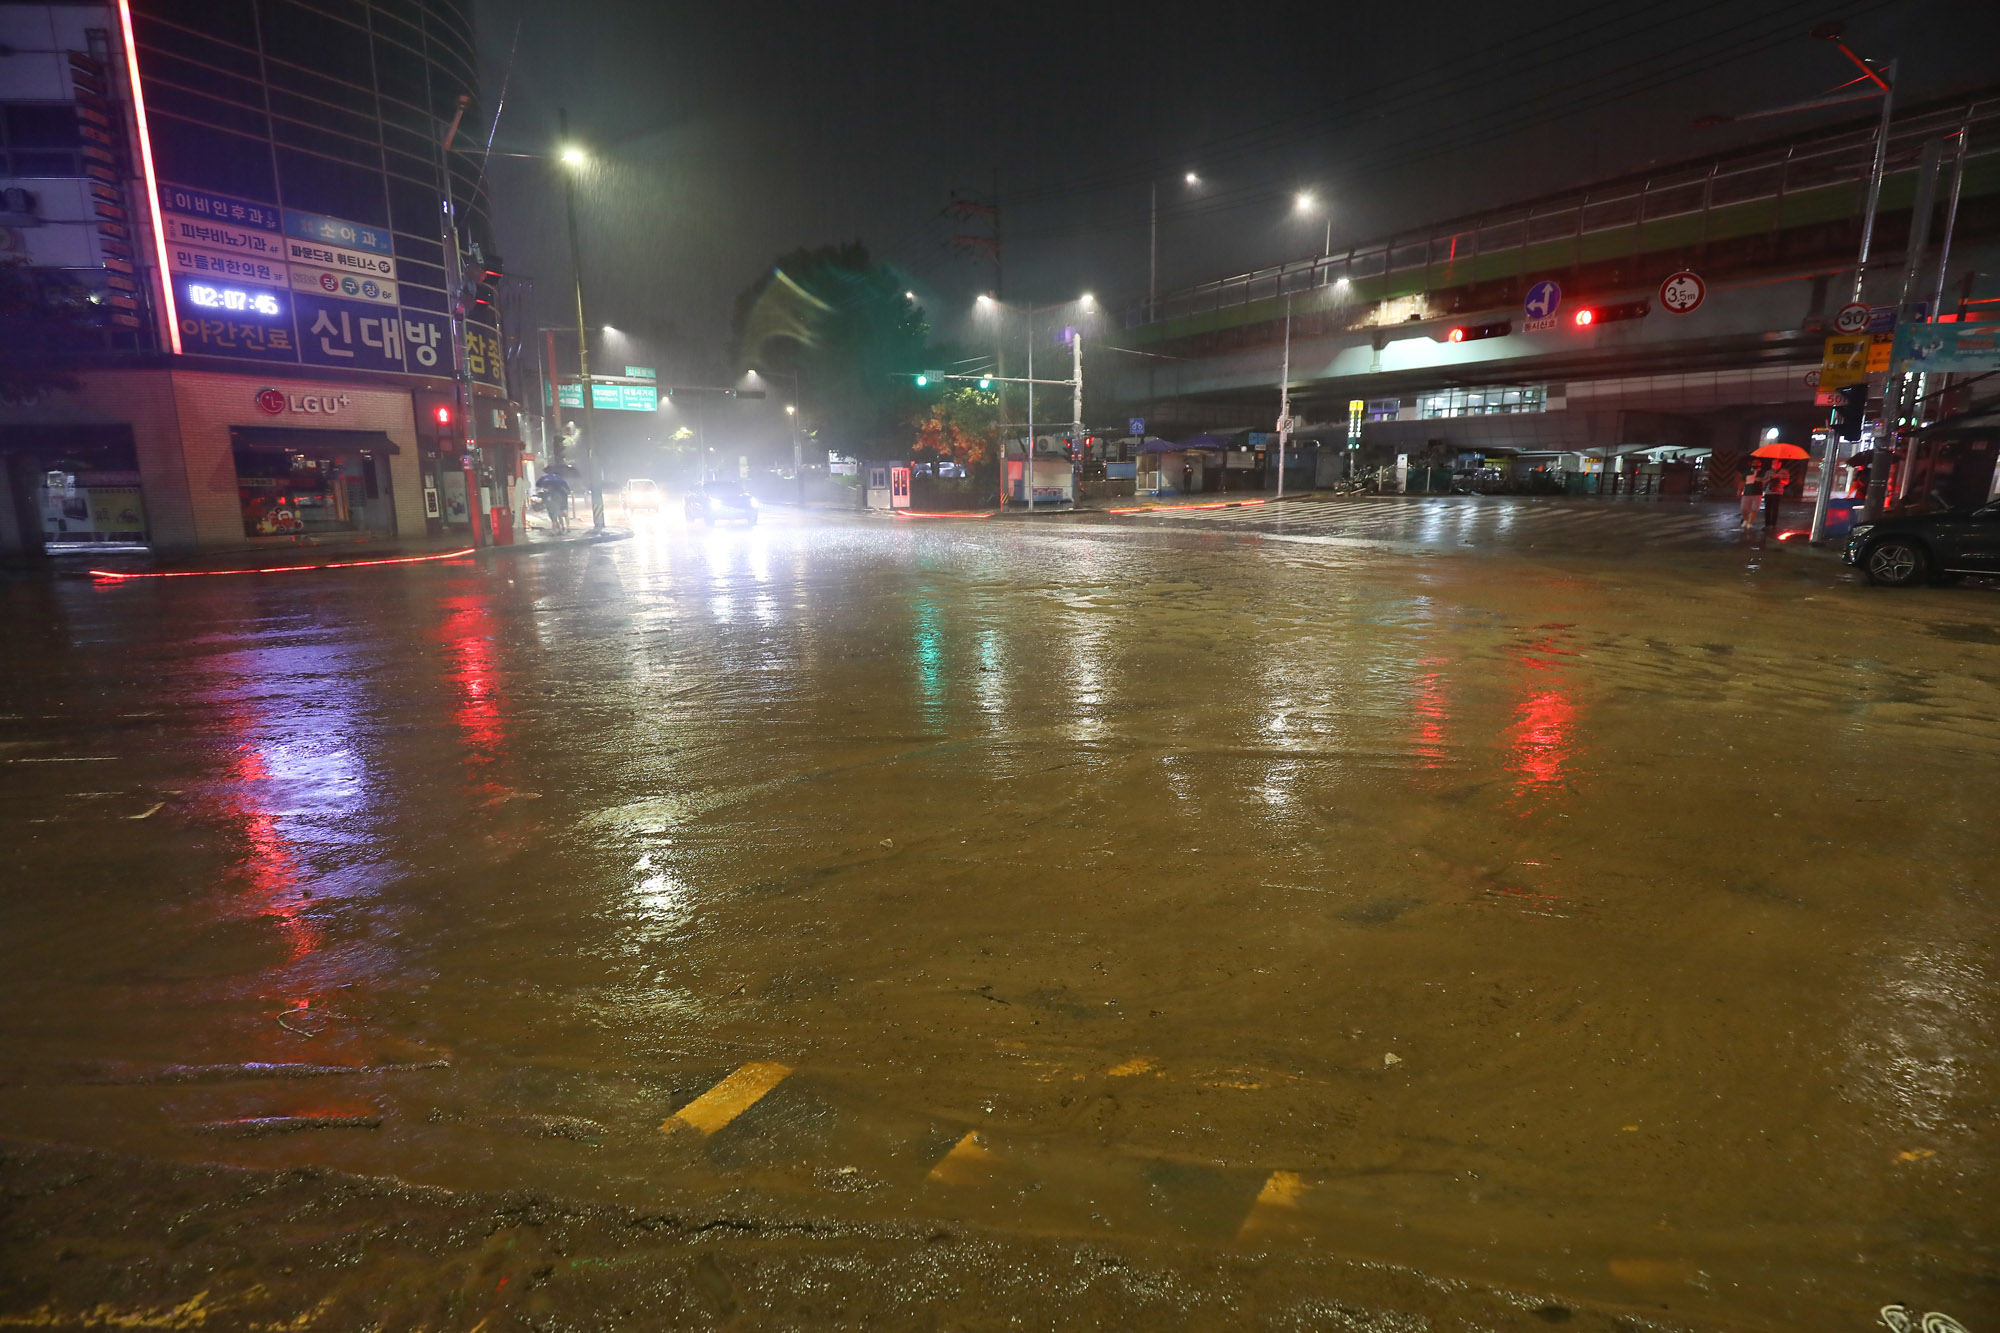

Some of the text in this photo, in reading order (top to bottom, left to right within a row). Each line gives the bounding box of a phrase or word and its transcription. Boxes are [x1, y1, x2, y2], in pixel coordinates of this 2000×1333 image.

[175, 193, 263, 224] 이비인후과
[181, 223, 267, 252] 피부비뇨기과
[320, 223, 377, 248] 소아과
[177, 251, 271, 280] 민들레한의원
[291, 245, 334, 263] 파운드짐
[382, 290, 392, 299] 6F
[1667, 286, 1696, 303] 3.5m
[1841, 310, 1864, 326] 30
[181, 319, 293, 350] 야간진료
[310, 309, 441, 367] 신대방
[1827, 394, 1848, 404] 50
